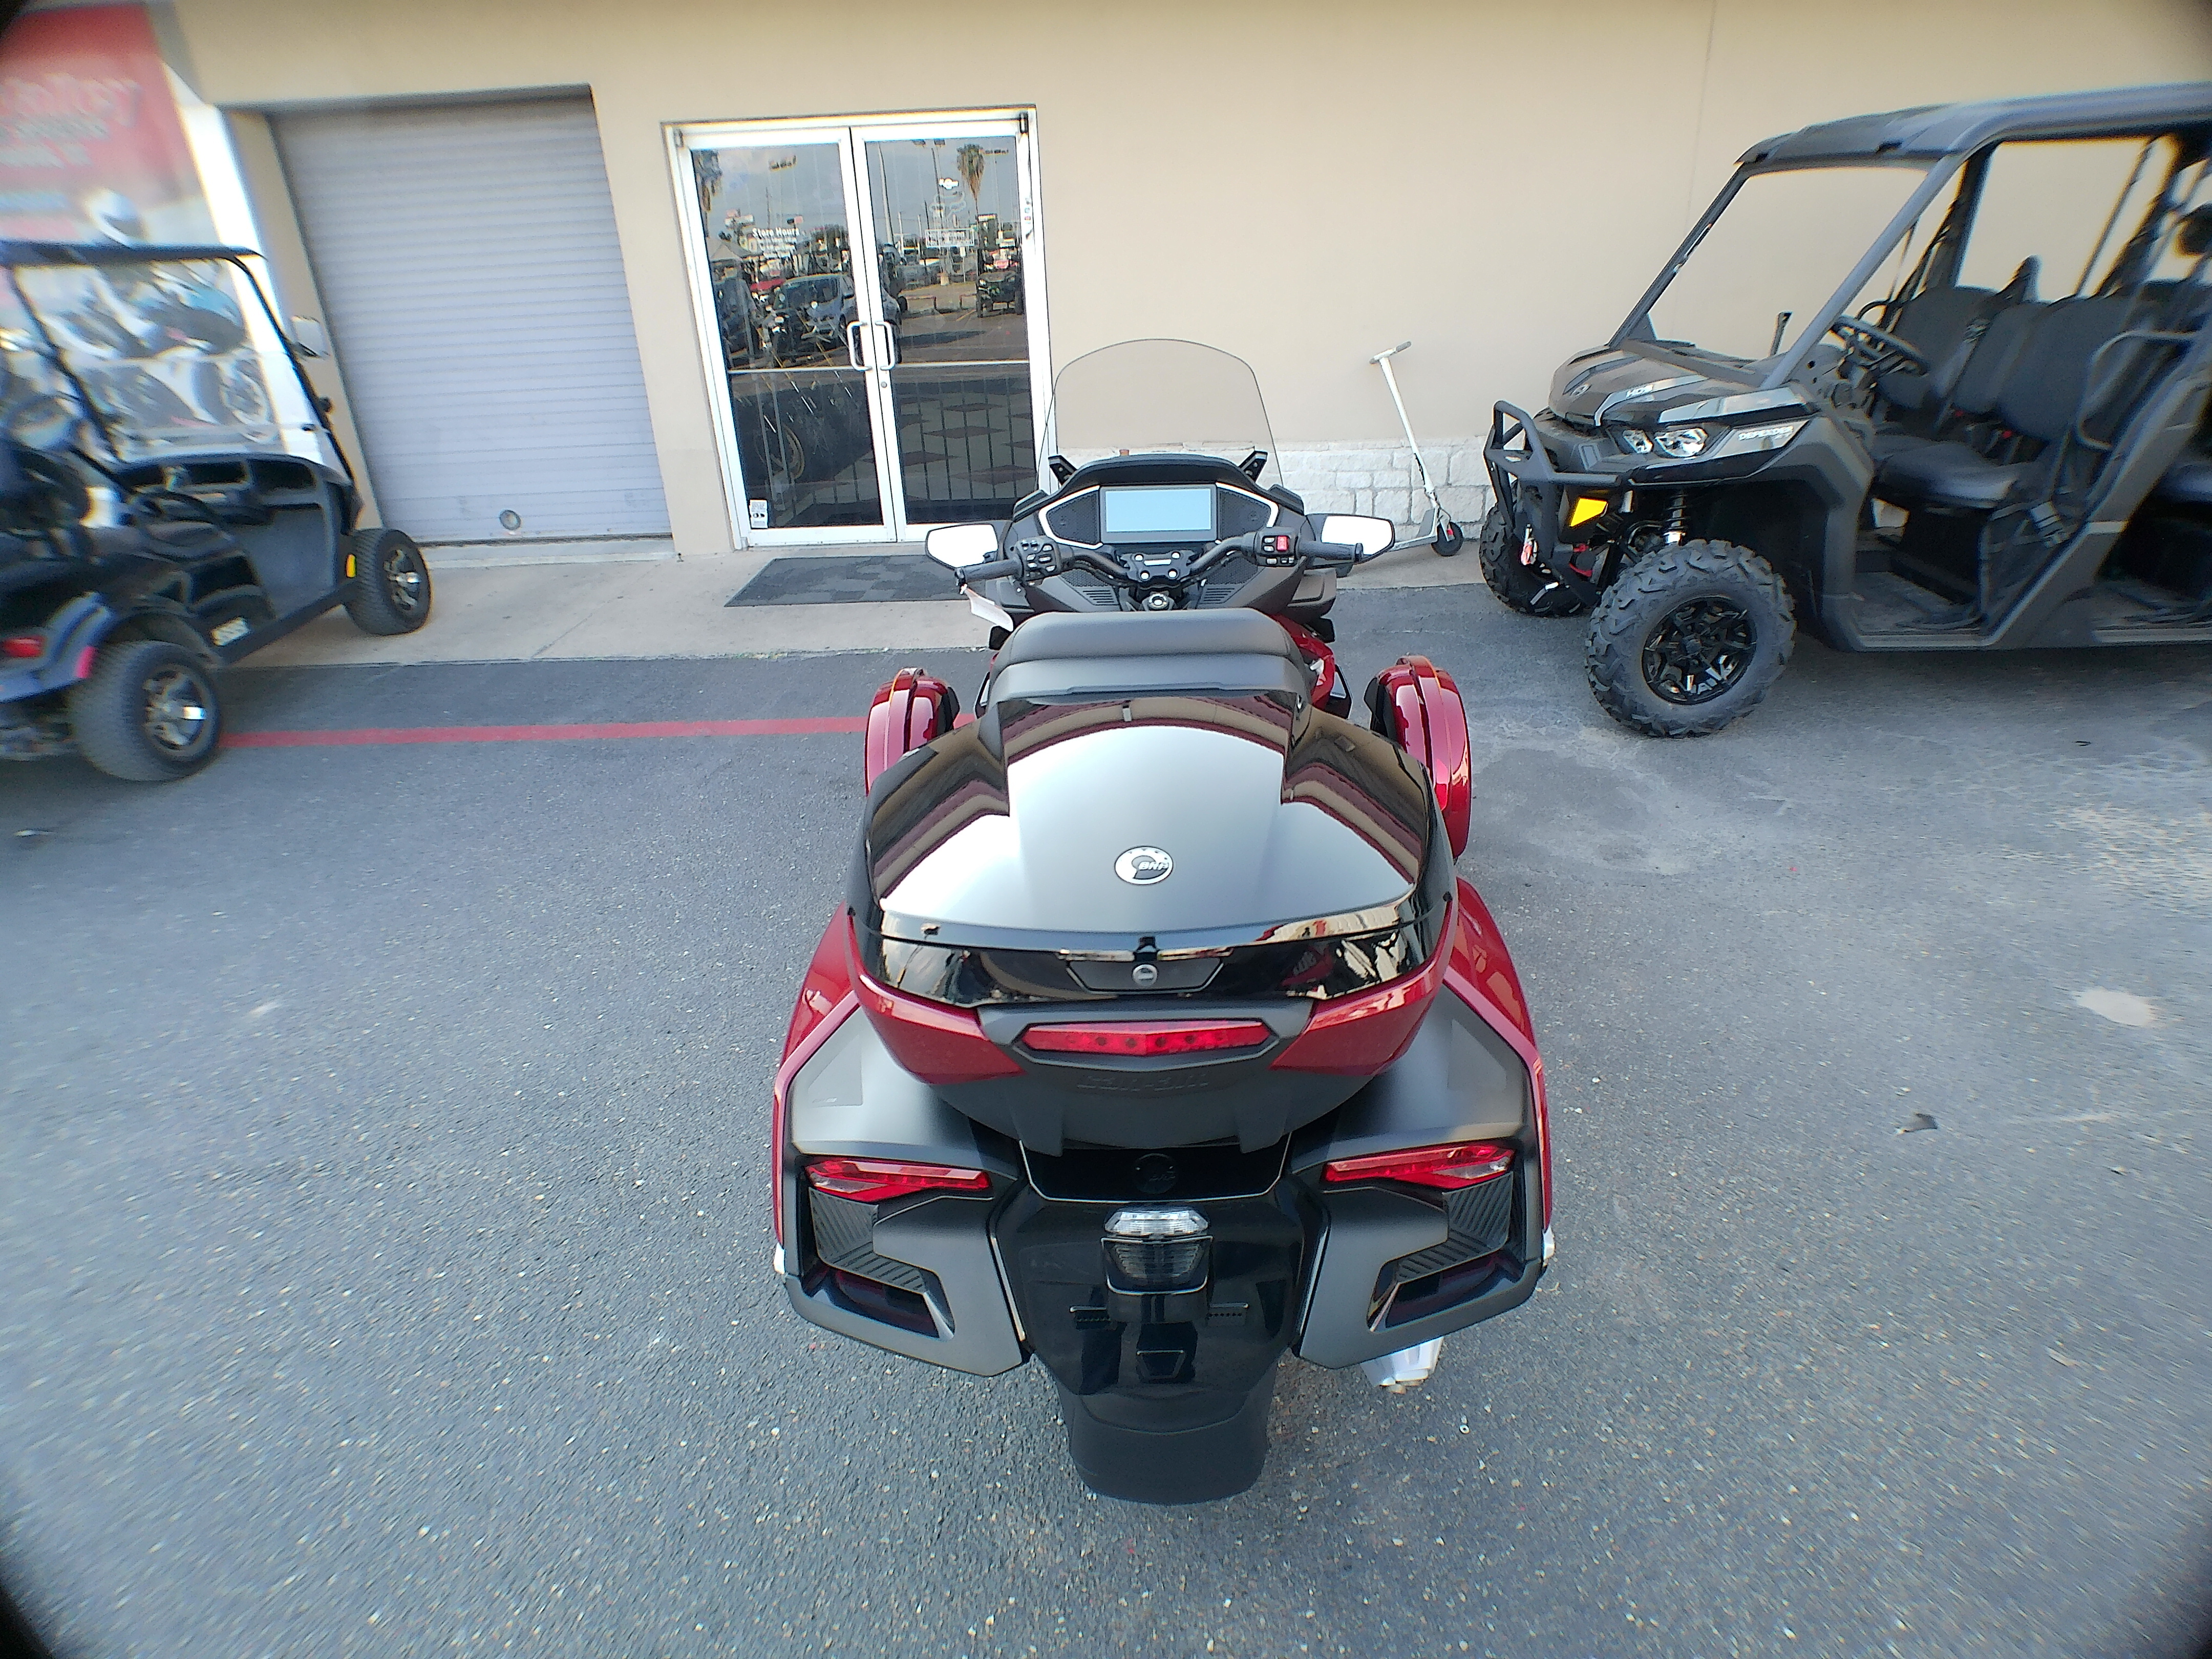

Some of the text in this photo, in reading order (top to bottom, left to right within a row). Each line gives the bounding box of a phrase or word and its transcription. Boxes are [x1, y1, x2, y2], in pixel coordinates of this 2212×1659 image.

[752, 227, 800, 237] Store Hours
[1738, 426, 1793, 440] DEFENDER
